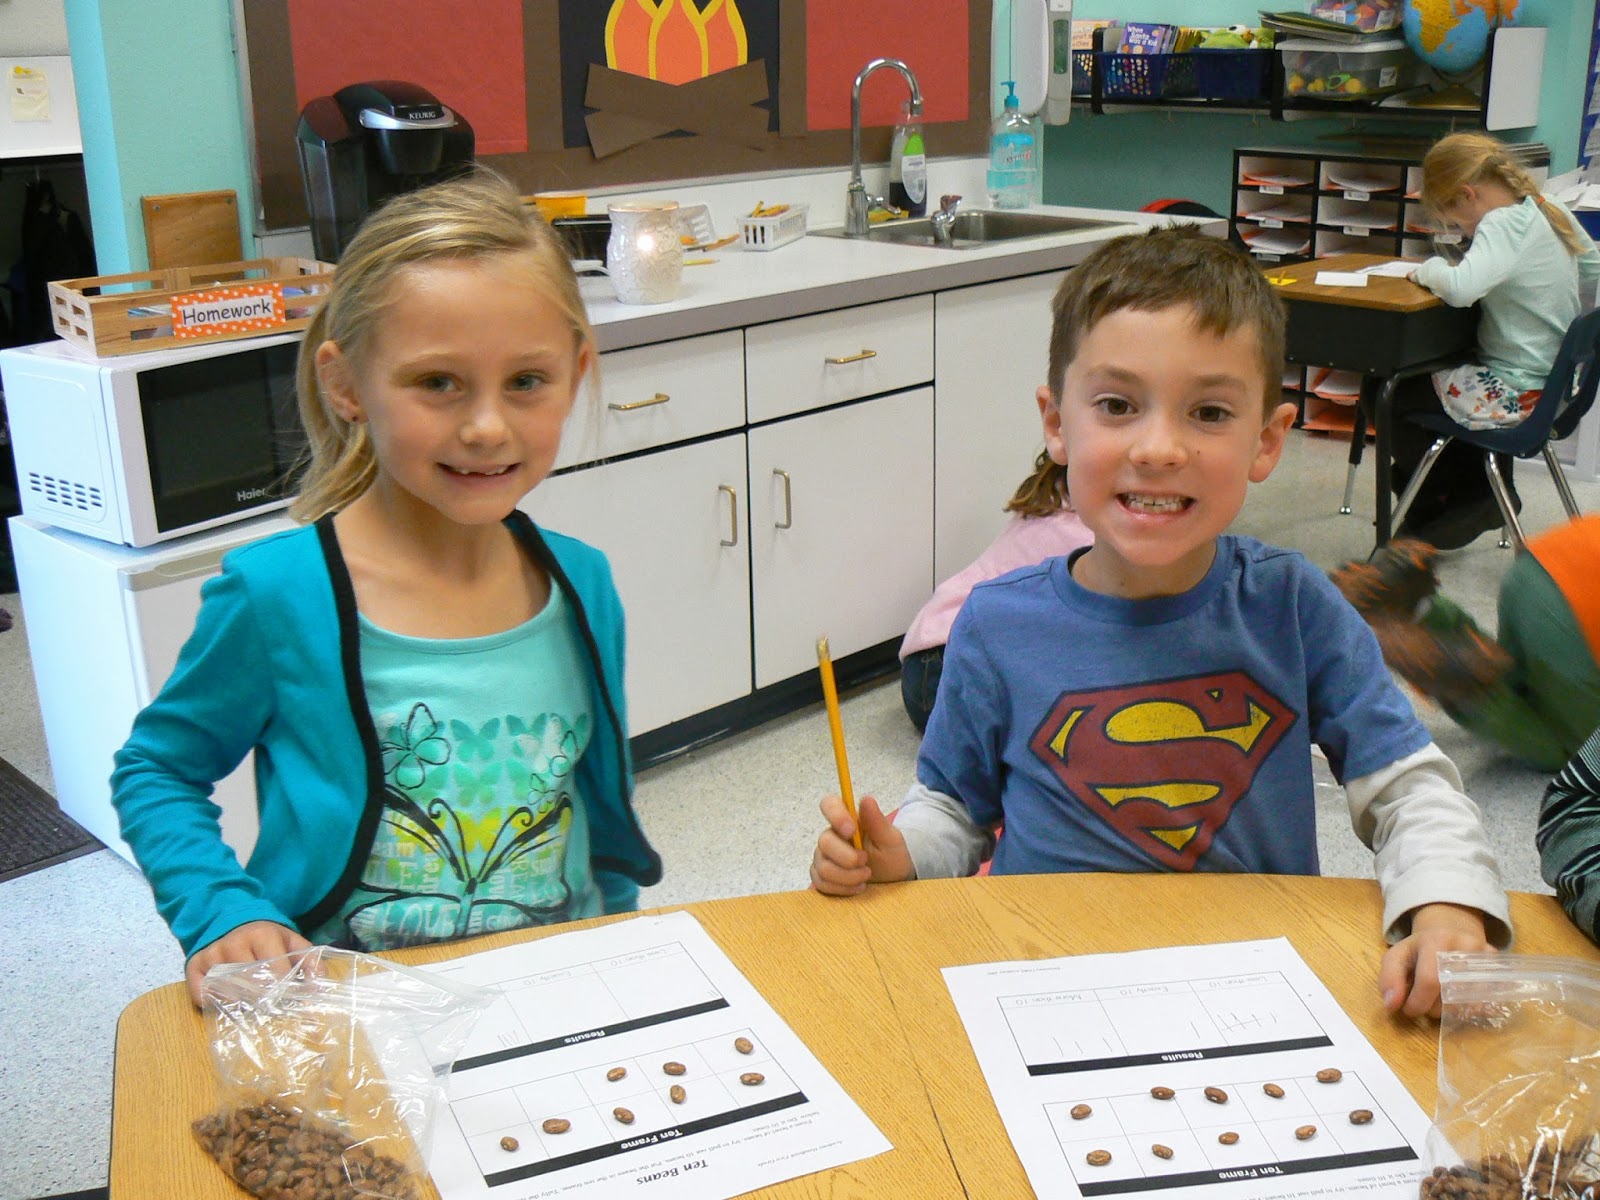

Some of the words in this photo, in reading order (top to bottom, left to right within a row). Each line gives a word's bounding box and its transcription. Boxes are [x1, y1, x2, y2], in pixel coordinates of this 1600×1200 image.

[409, 111, 436, 120] KEURIG
[182, 298, 272, 325] Homework
[236, 487, 266, 502] Haier
[609, 958, 622, 967] 10
[1118, 988, 1132, 996] 10
[564, 1030, 606, 1044] Results
[1161, 1051, 1203, 1062] Results
[659, 1129, 683, 1140] Ten
[620, 1134, 658, 1149] Frame
[683, 1158, 708, 1172] Ten
[1260, 1165, 1284, 1174] Ten
[636, 1168, 679, 1185] Beans
[1219, 1168, 1258, 1179] Frame
